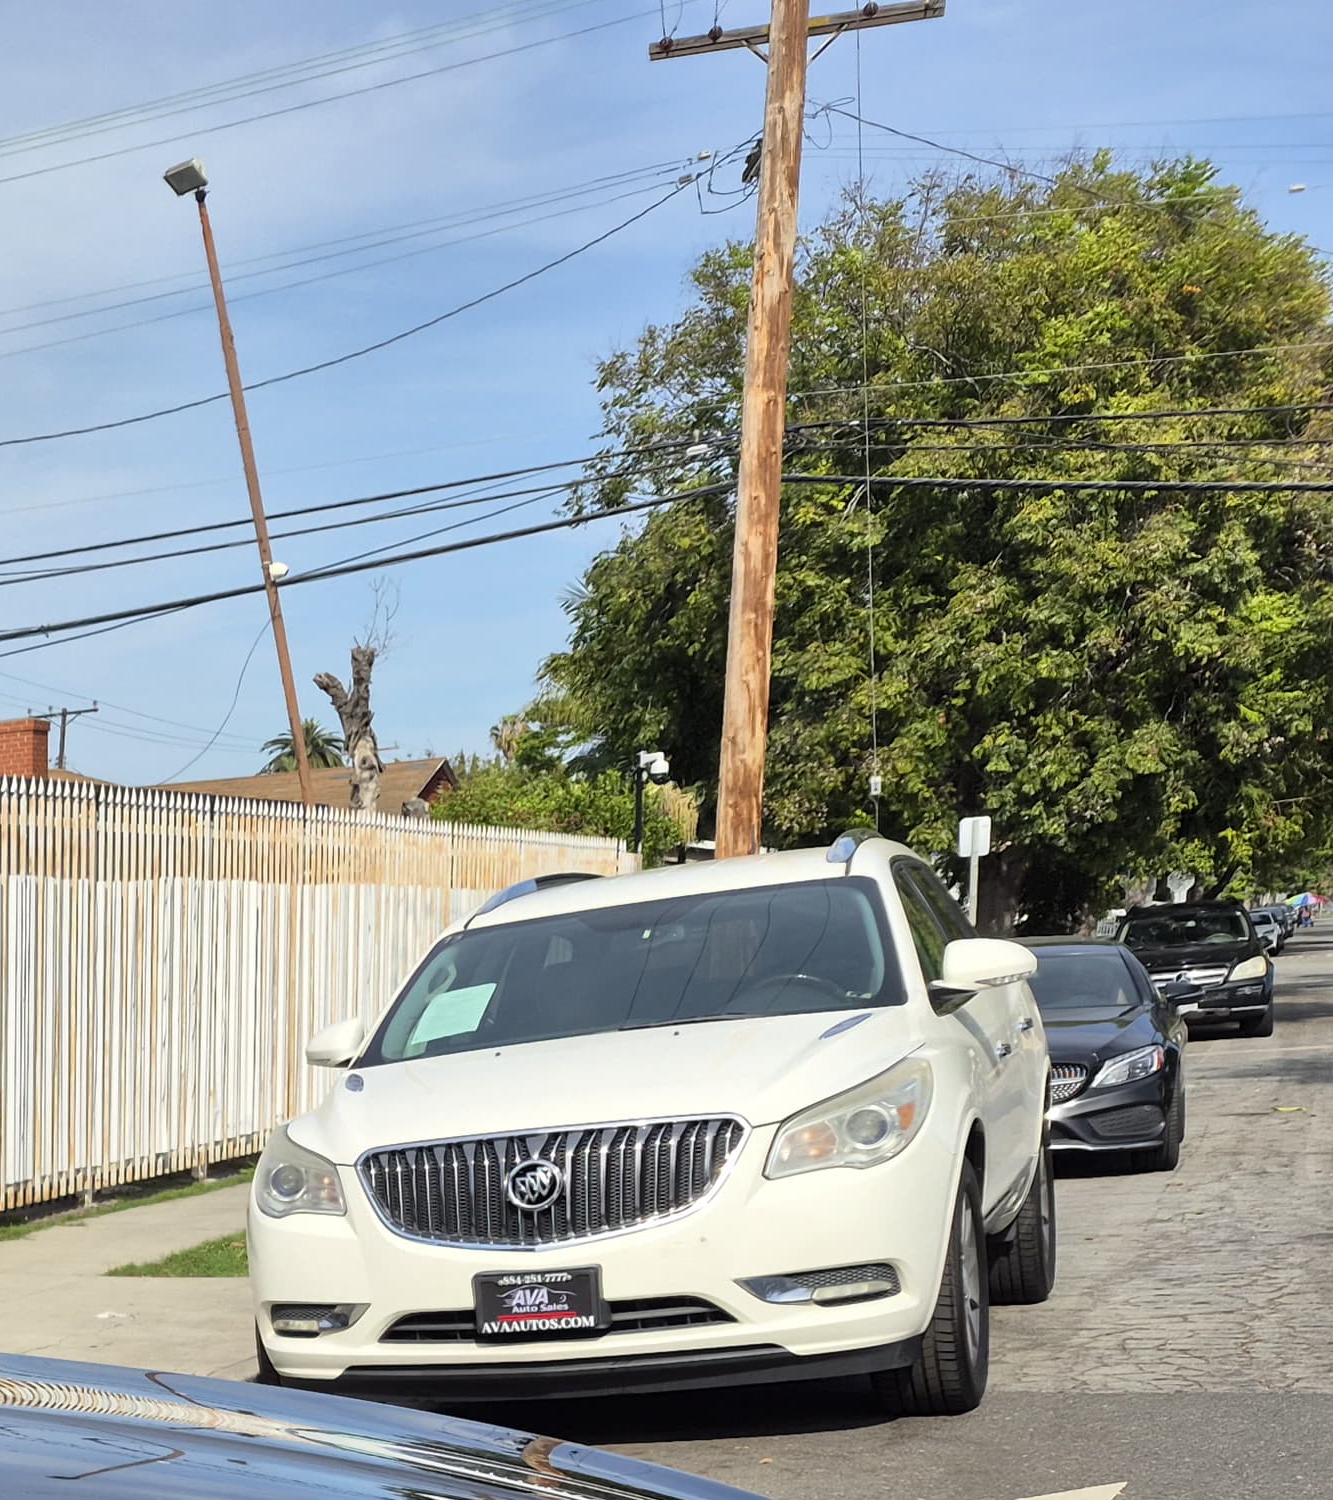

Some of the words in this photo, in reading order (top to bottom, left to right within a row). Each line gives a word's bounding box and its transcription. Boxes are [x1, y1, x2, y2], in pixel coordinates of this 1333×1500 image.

[511, 1288, 549, 1306] AVA
[512, 1304, 538, 1314] Auto
[540, 1303, 569, 1313] Sales
[481, 1315, 595, 1334] AVAAUTOS.COM
